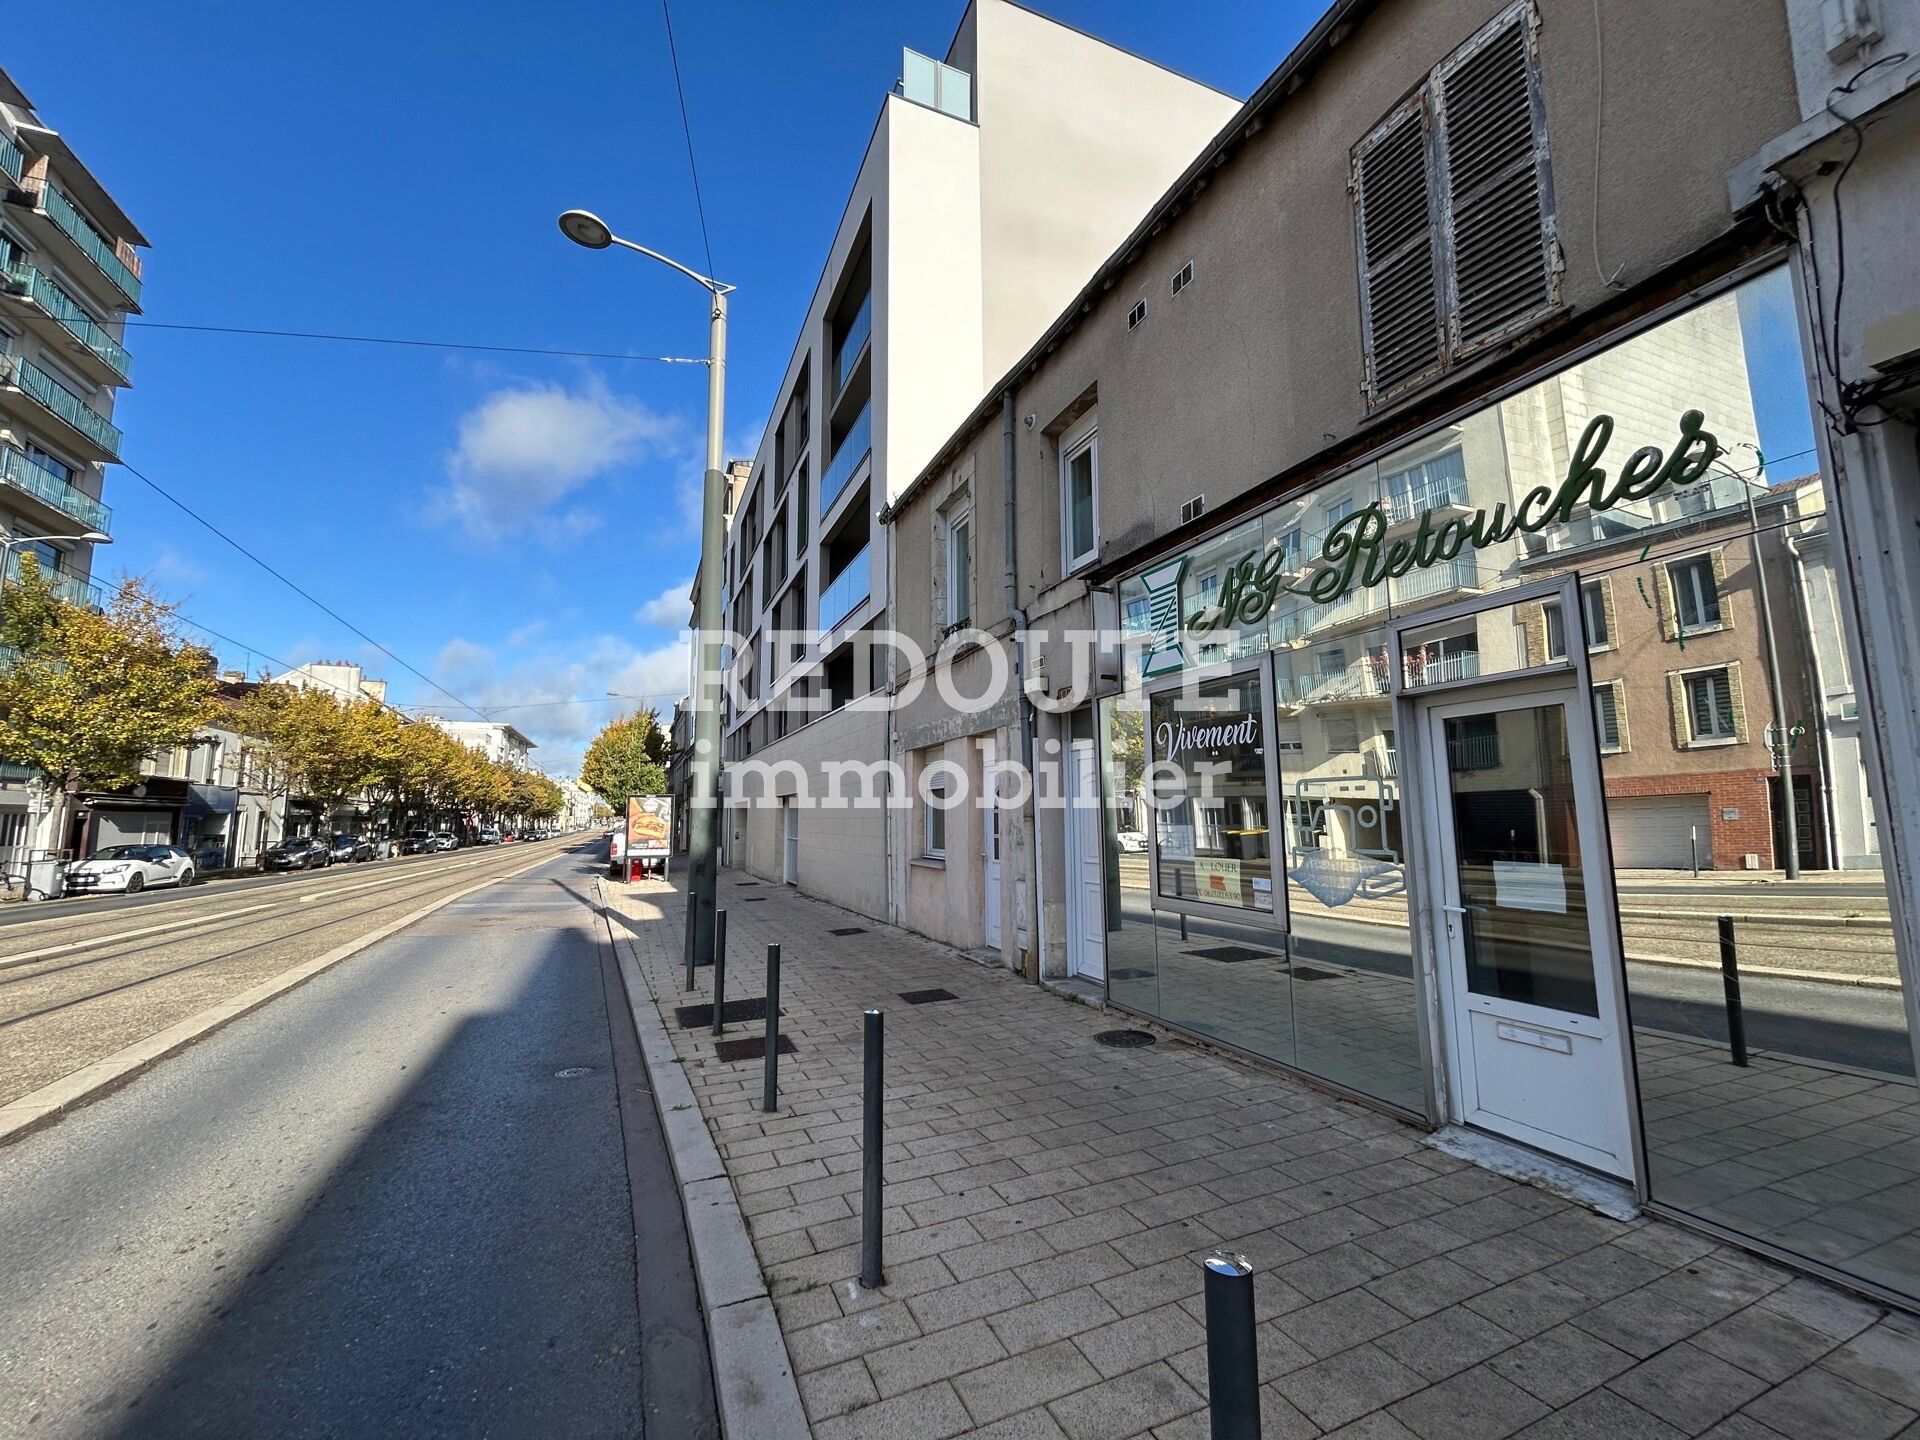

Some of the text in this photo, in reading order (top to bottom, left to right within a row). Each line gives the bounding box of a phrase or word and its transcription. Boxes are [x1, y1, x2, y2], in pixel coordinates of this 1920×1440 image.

[1283, 409, 1718, 603] Retouches
[1156, 713, 1258, 762] Vivement
[1210, 862, 1238, 873] LOUER
